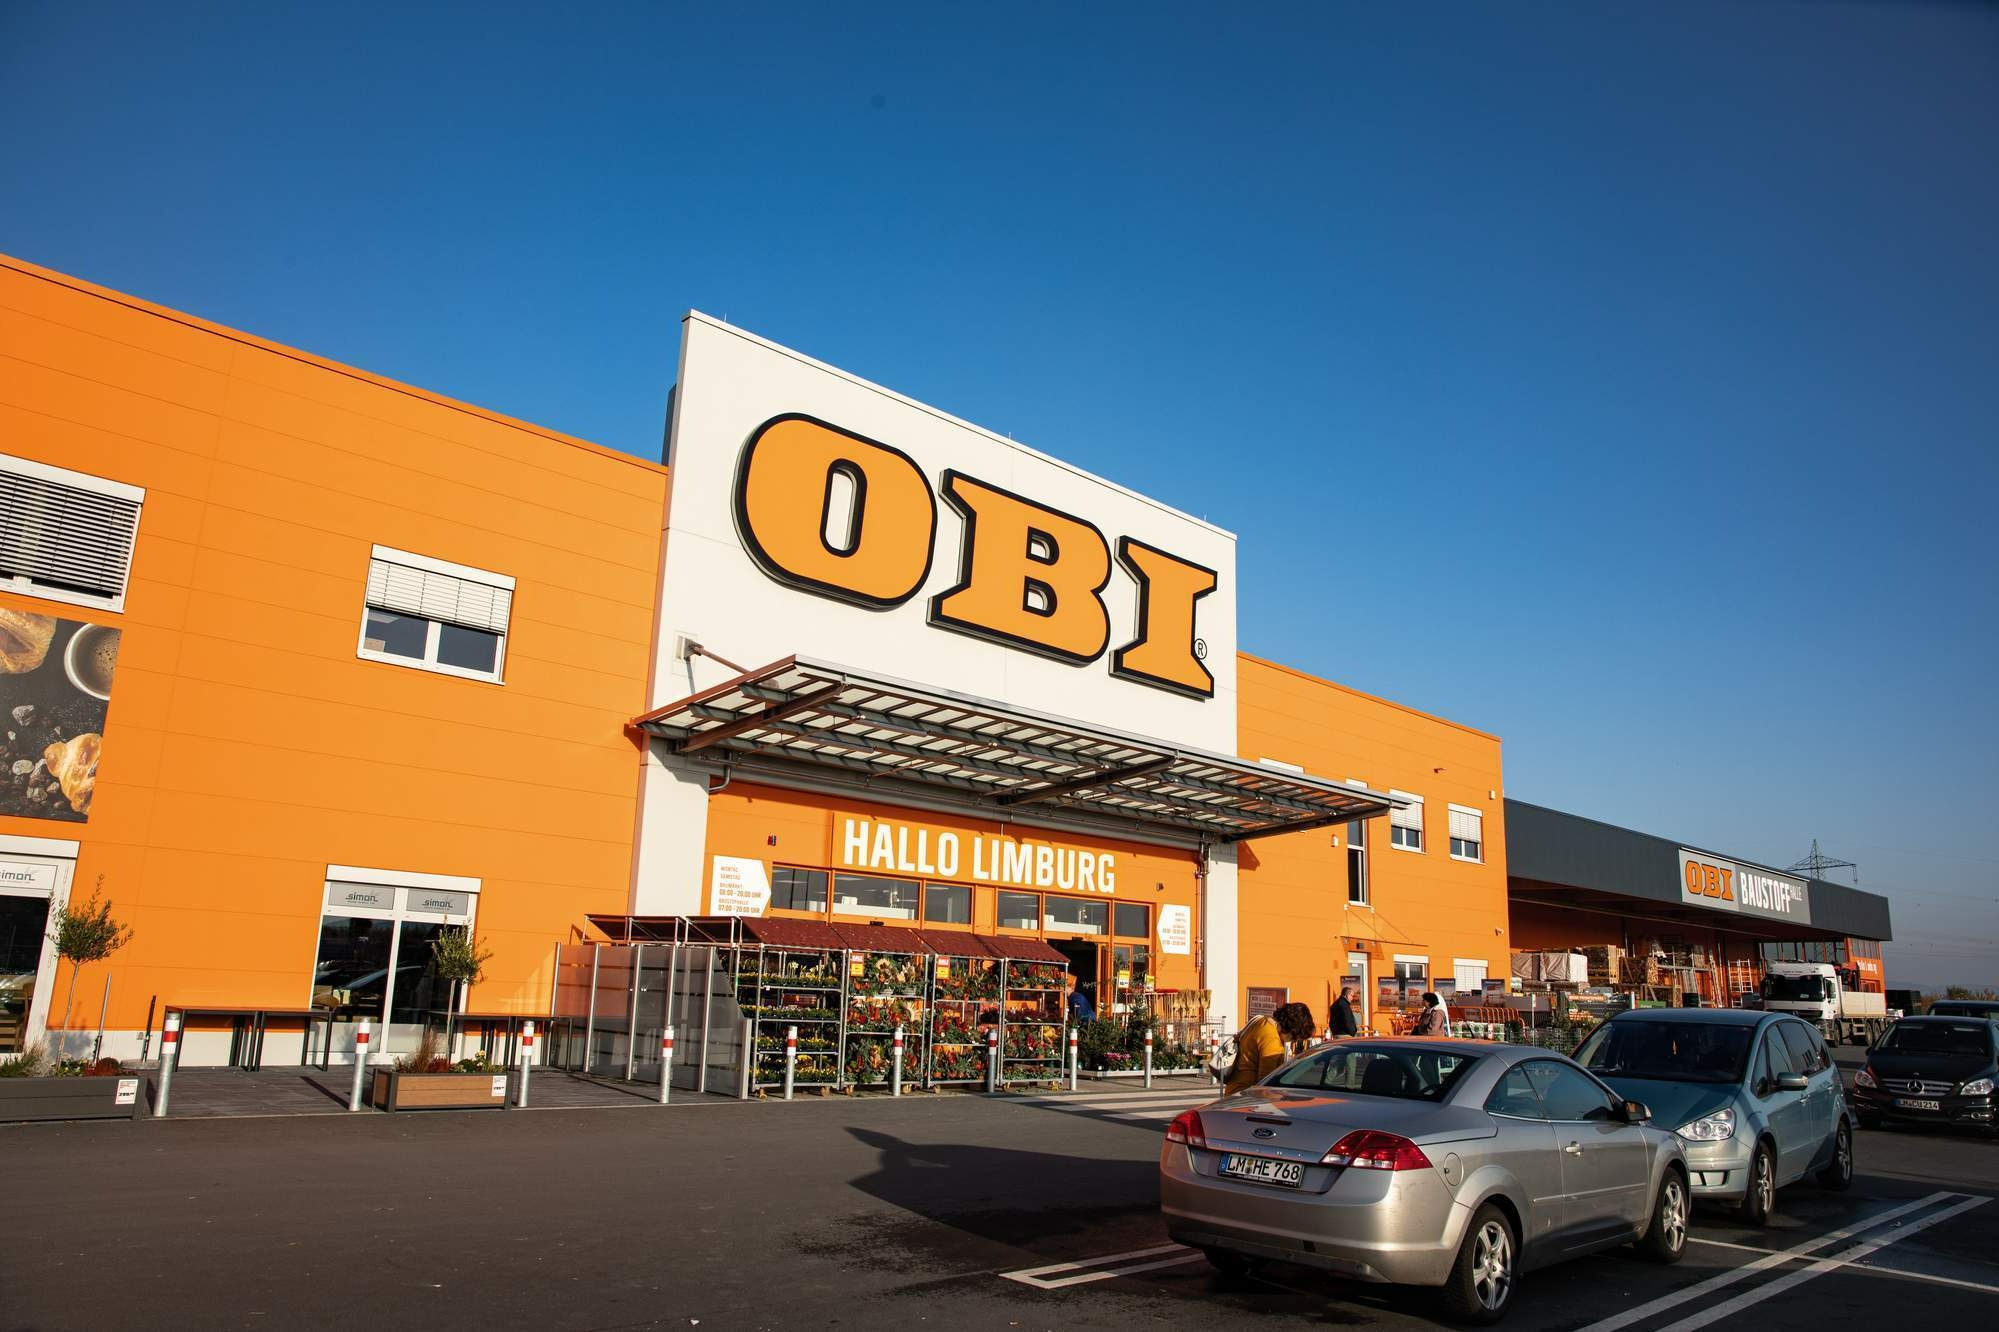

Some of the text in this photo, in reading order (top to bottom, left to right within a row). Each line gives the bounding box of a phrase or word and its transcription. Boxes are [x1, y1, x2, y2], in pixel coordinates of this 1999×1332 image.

[732, 412, 1217, 701] OBI
[843, 819, 1115, 894] HALLO LIMBURG
[345, 891, 378, 902] simon
[1685, 860, 1734, 901] OBI
[1740, 872, 1791, 913] BAUSTOFF
[422, 898, 453, 909] simon
[1923, 1101, 1937, 1109] 214
[1227, 1155, 1246, 1172] LM
[1253, 1159, 1272, 1176] HE
[1273, 1162, 1300, 1181] 768
